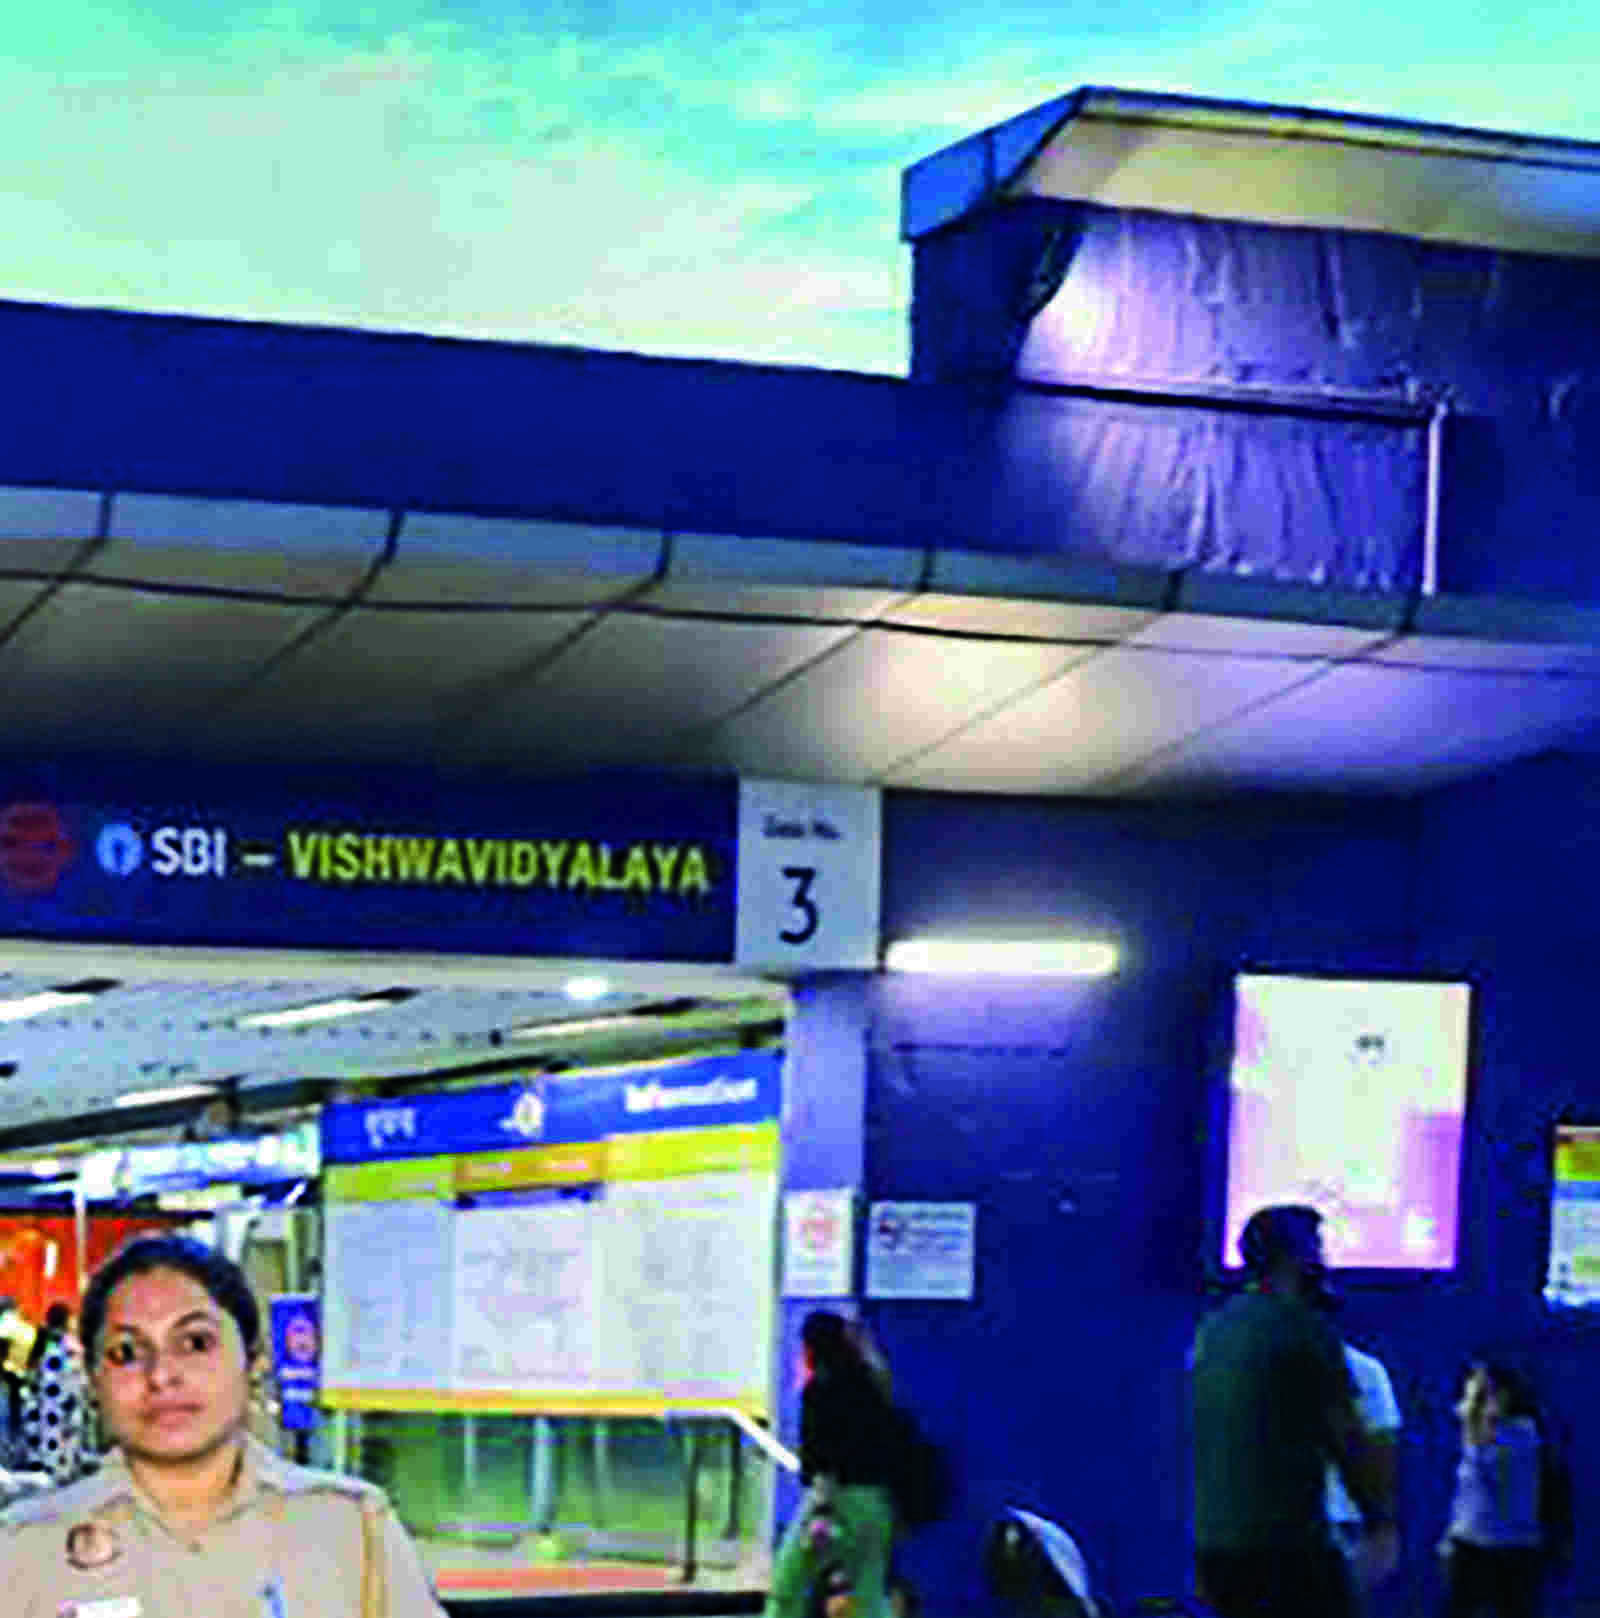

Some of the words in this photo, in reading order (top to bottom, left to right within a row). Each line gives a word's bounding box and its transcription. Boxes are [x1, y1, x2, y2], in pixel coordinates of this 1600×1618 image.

[150, 826, 228, 878] SBI
[287, 830, 712, 894] VISHWAVIDYALAYA
[779, 865, 819, 944] 3
